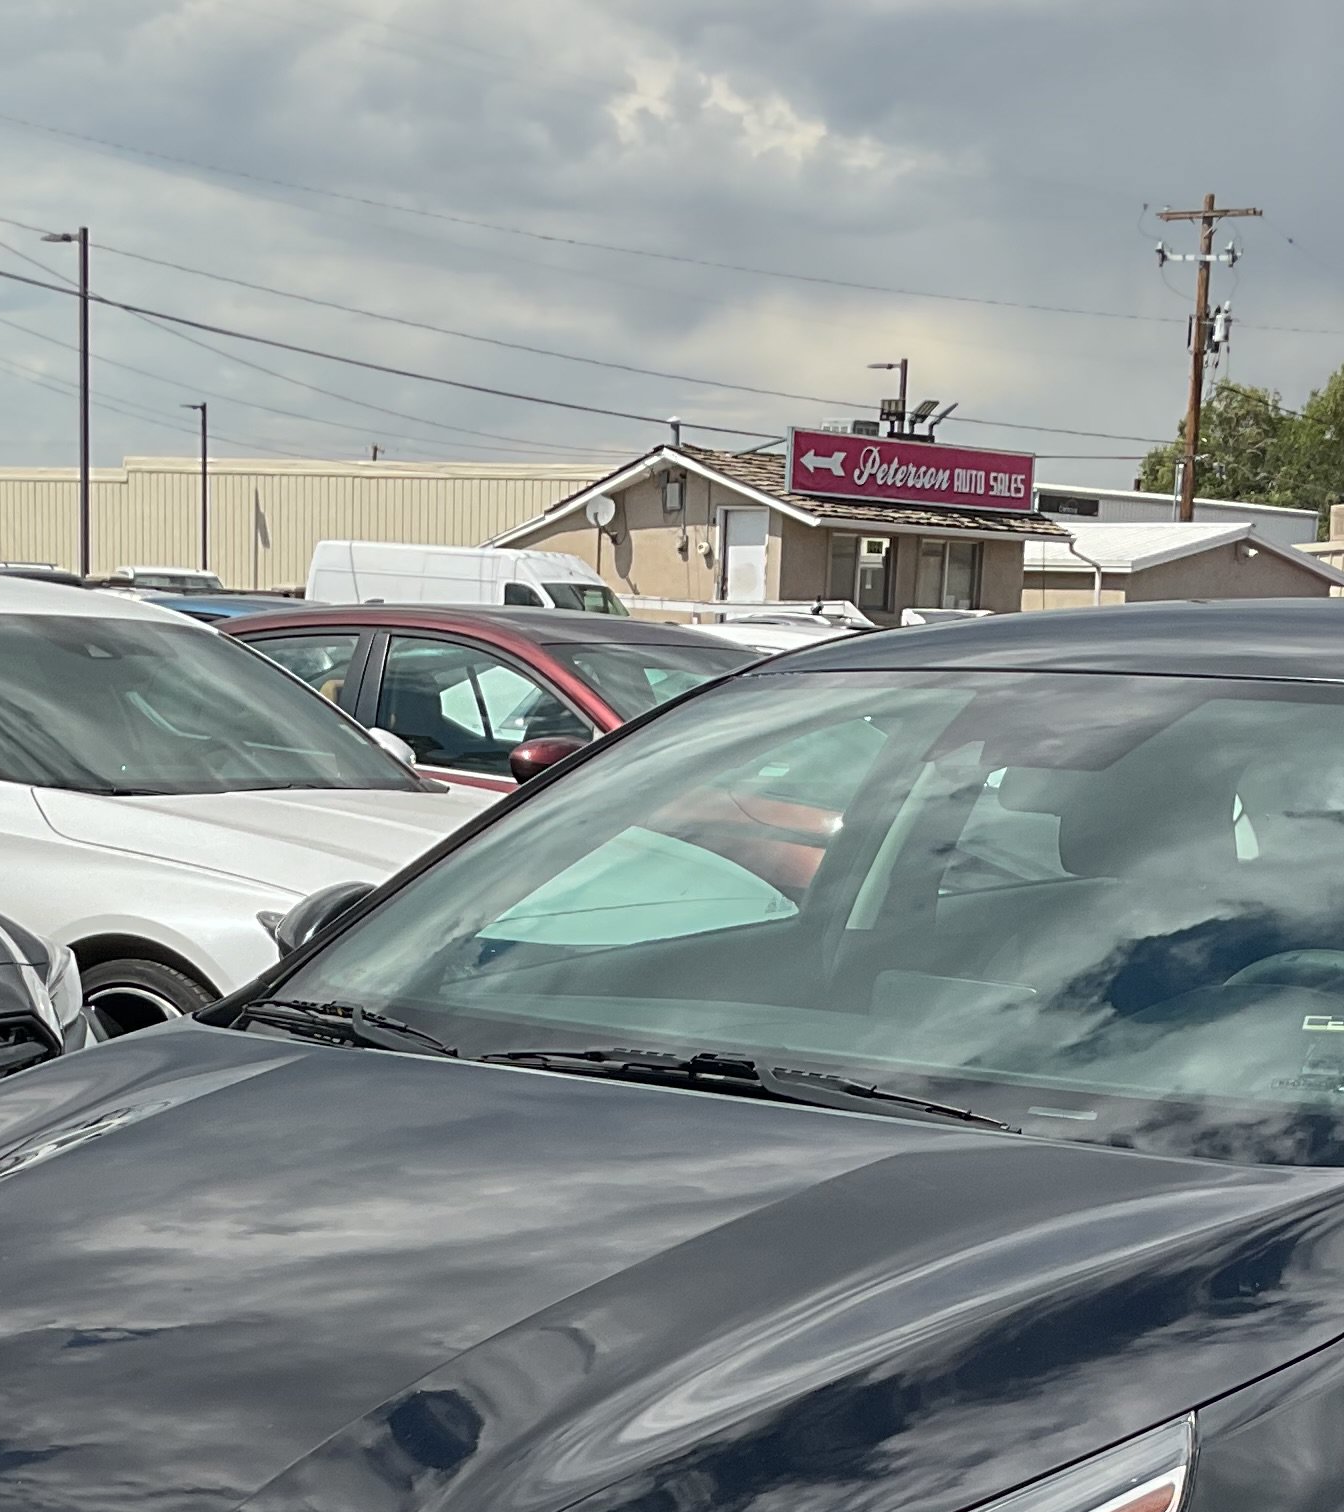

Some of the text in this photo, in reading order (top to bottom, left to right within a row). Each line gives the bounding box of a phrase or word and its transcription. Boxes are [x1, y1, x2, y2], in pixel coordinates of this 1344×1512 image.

[853, 446, 1025, 498] Peterson AUTO SALES
